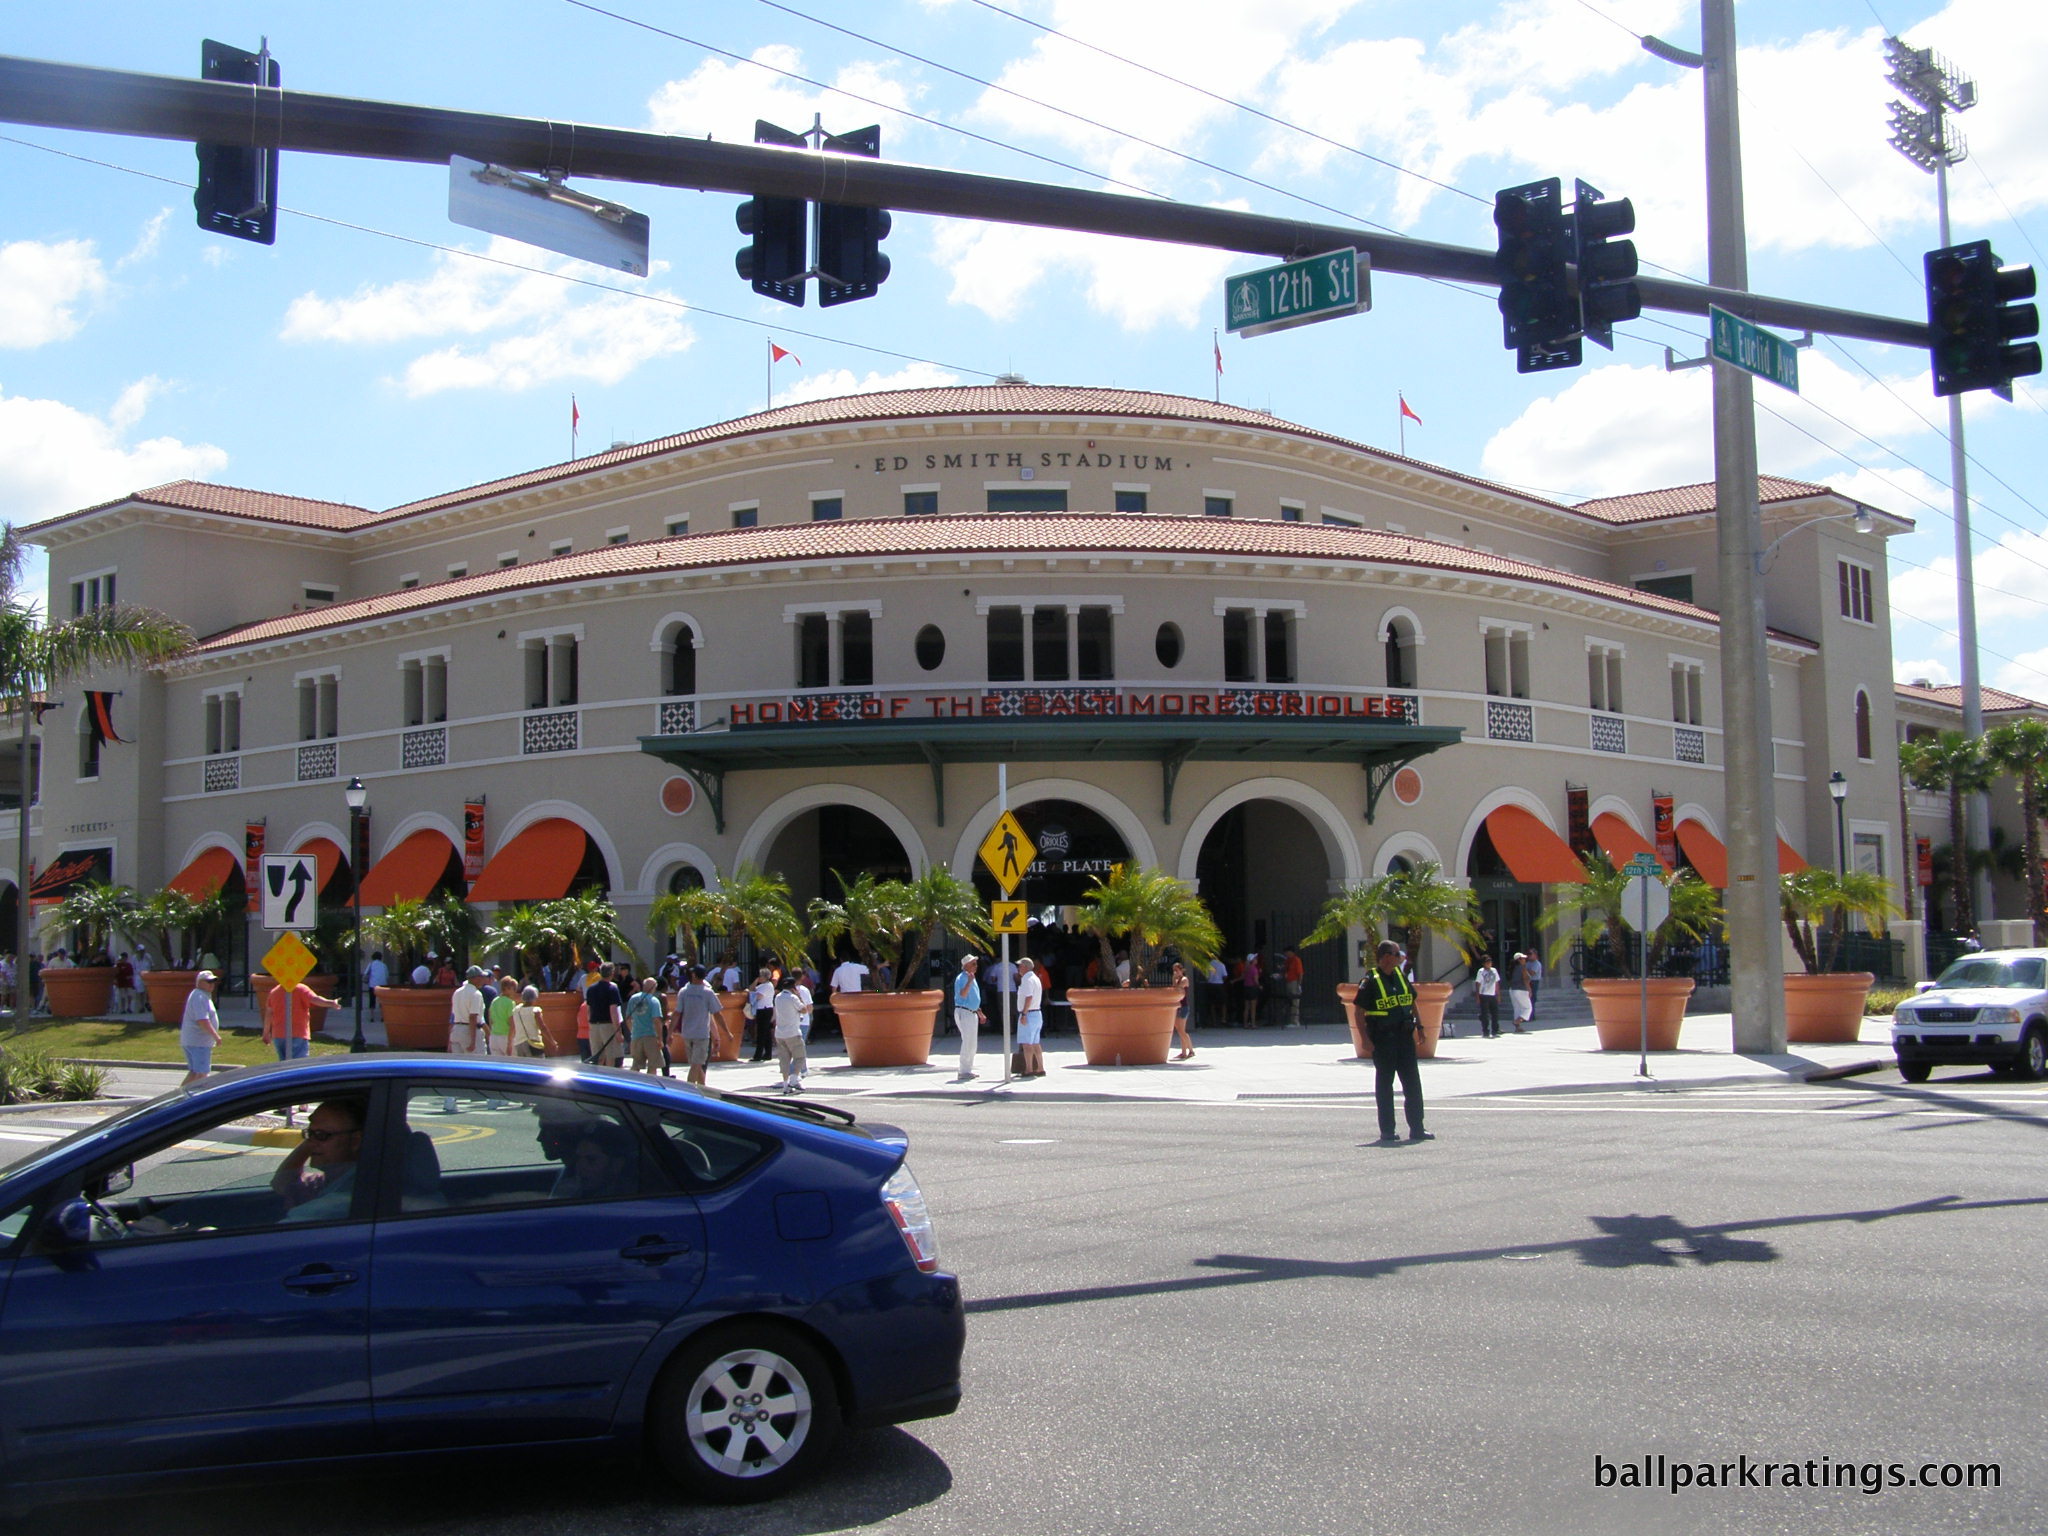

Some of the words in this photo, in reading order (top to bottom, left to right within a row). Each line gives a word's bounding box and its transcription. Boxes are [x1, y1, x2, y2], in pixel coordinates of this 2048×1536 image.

[1269, 267, 1313, 315] 12th
[1328, 258, 1350, 302] St
[1738, 325, 1770, 374] Euclid
[1777, 343, 1795, 386] Ave
[875, 456, 909, 472] ED
[926, 453, 1023, 469] SMITH
[1041, 452, 1173, 471] STADIUM
[730, 700, 840, 723] HOME
[860, 697, 911, 720] OF
[925, 695, 1003, 718] THE
[1022, 694, 1237, 716] BALTIMORE
[1253, 693, 1407, 718] ORIOLES
[71, 823, 108, 833] TICKETS
[1039, 835, 1069, 848] ORIOLES
[1063, 860, 1112, 872] PLATE
